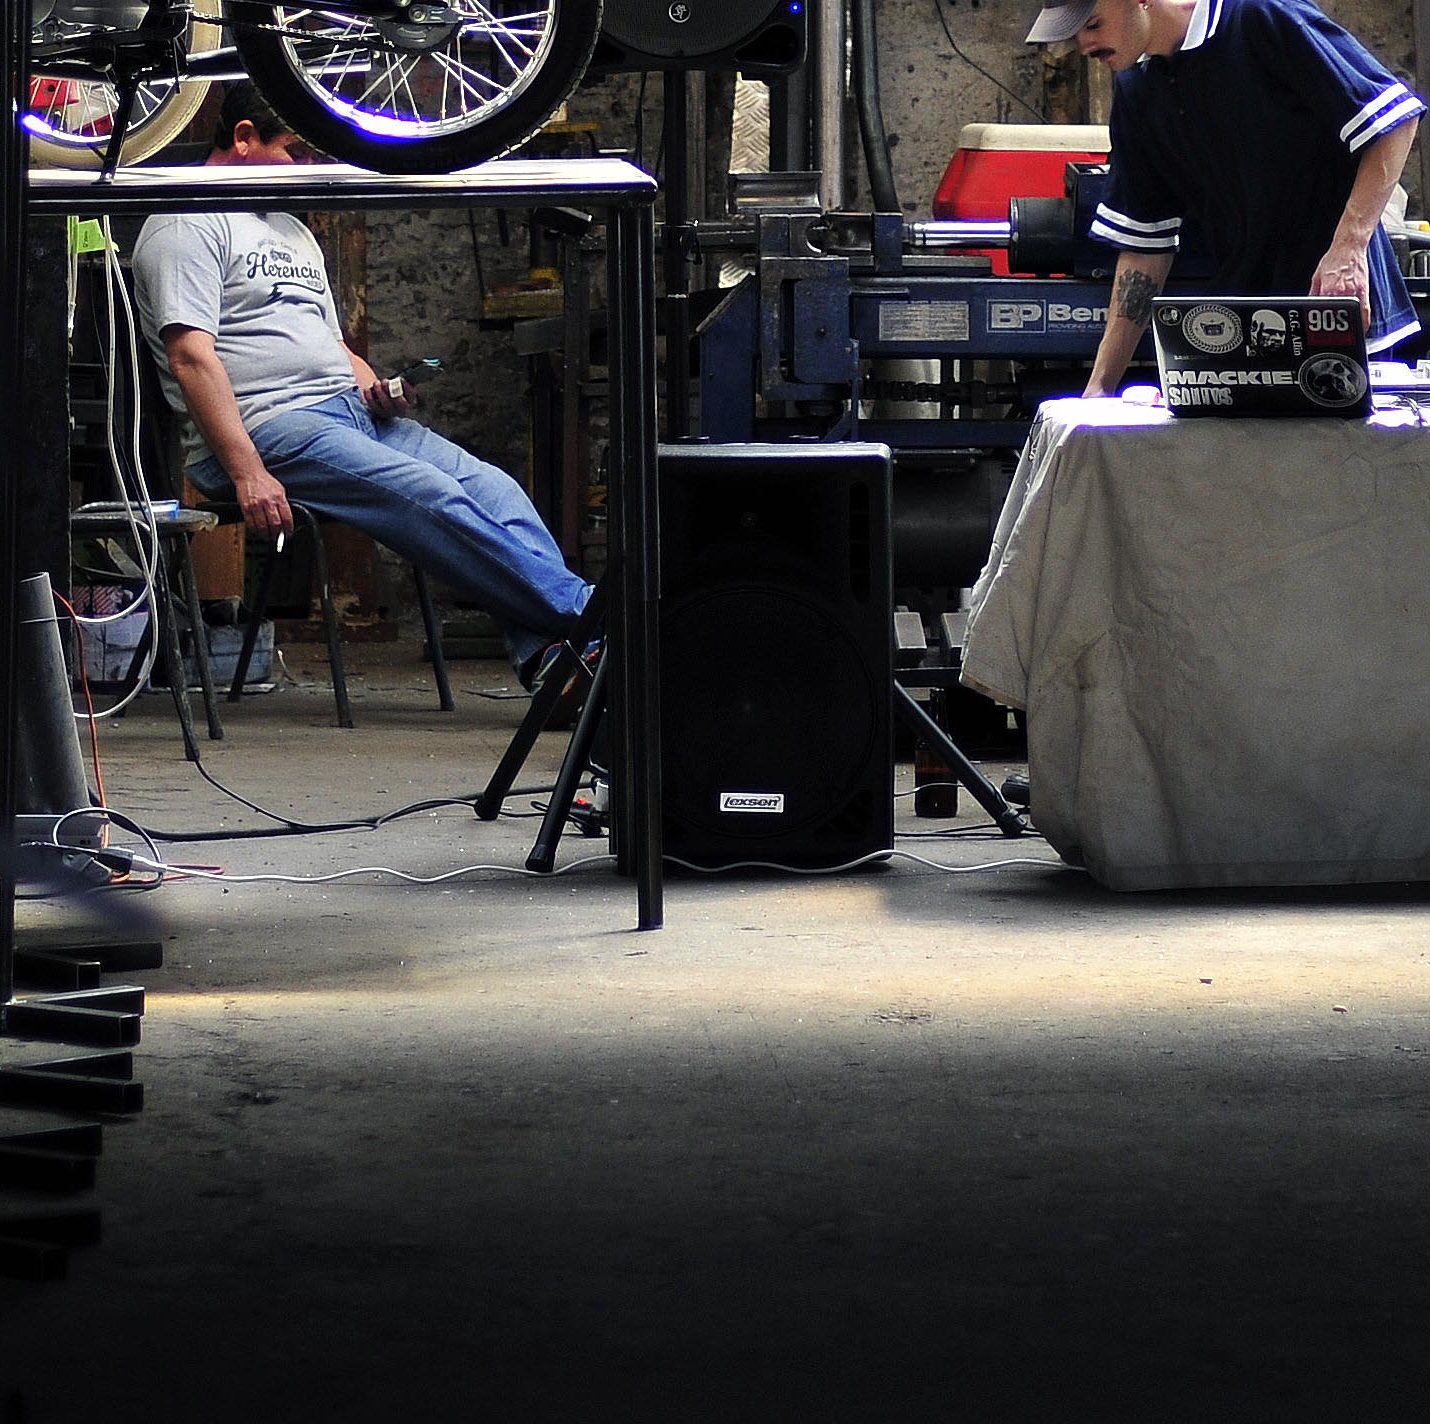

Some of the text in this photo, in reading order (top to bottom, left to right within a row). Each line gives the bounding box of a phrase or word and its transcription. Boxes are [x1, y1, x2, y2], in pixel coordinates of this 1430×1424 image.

[246, 251, 321, 279] Herencia
[991, 303, 1043, 329] BP
[1308, 309, 1350, 332] 90S
